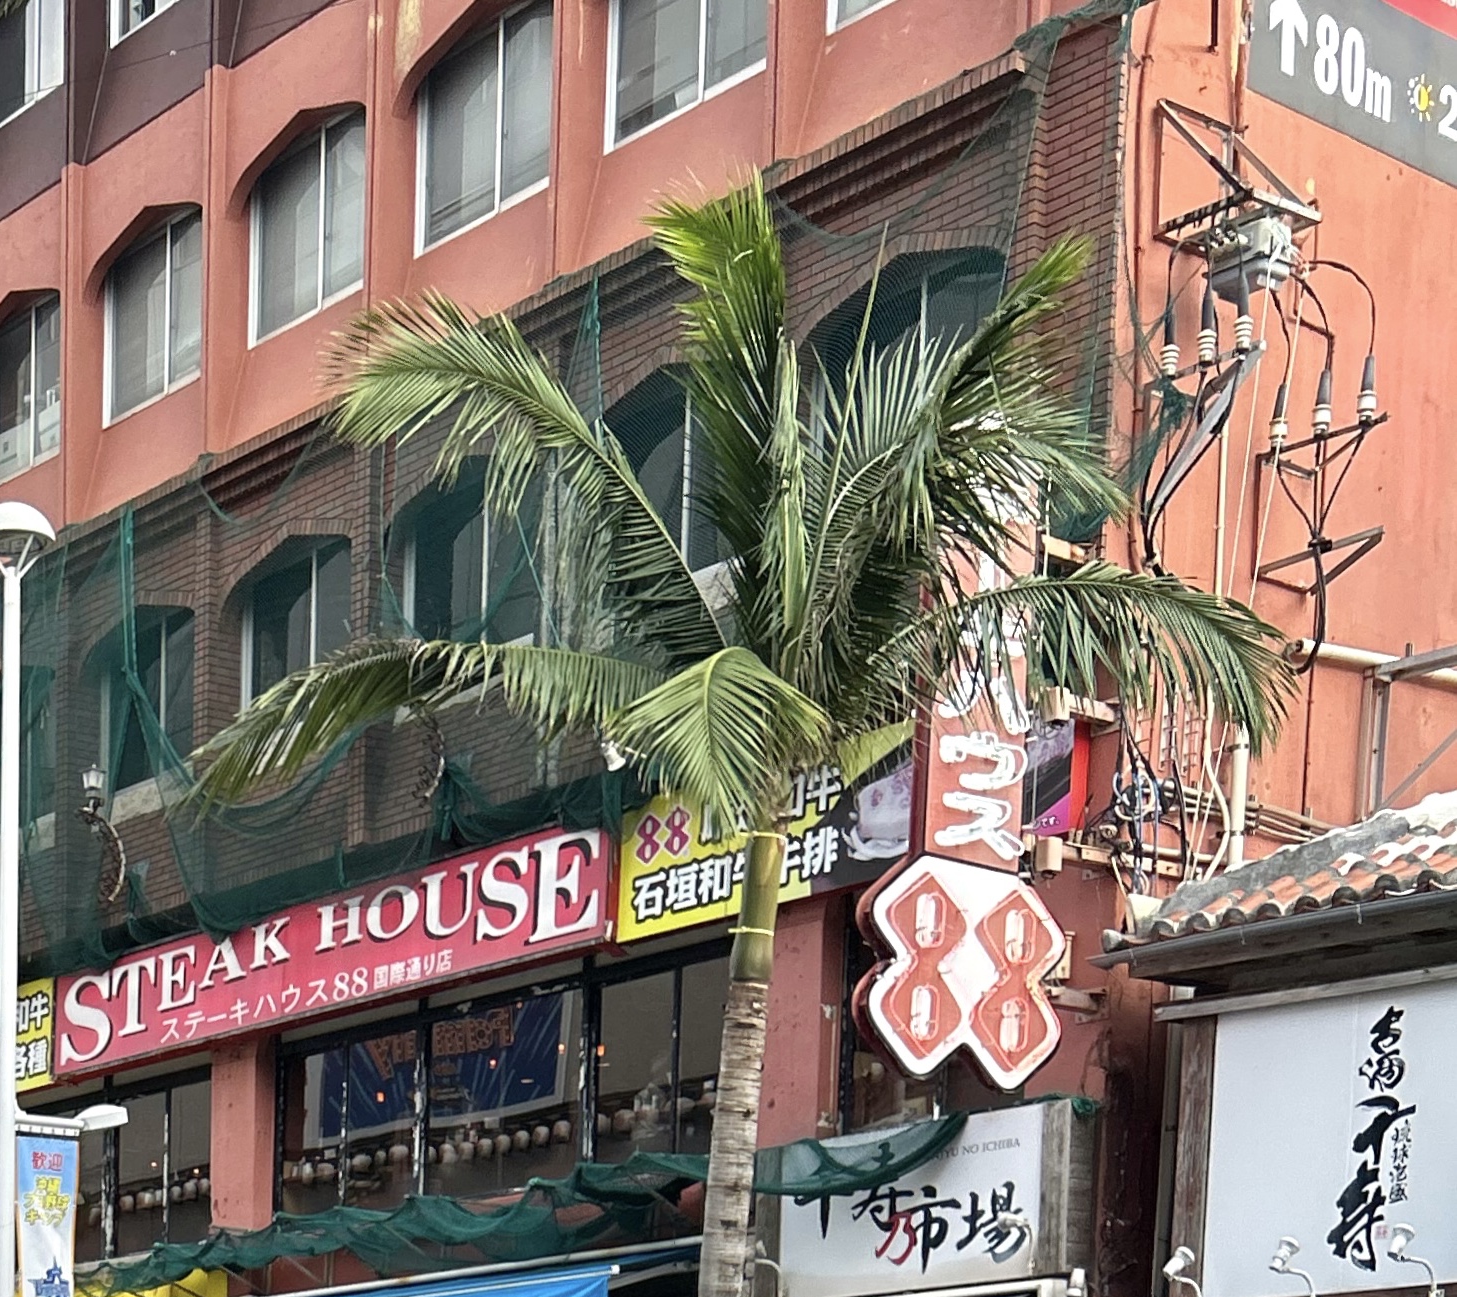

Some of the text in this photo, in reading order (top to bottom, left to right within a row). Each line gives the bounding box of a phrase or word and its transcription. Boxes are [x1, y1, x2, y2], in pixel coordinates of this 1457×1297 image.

[1313, 14, 1392, 123] 80m
[635, 805, 691, 865] 88
[59, 915, 292, 1067] STEAK
[314, 827, 601, 952] HOUSE
[159, 966, 369, 1044] ステーキハウス88
[373, 948, 454, 990] 国際通り店
[32, 1151, 63, 1172] 歓迎
